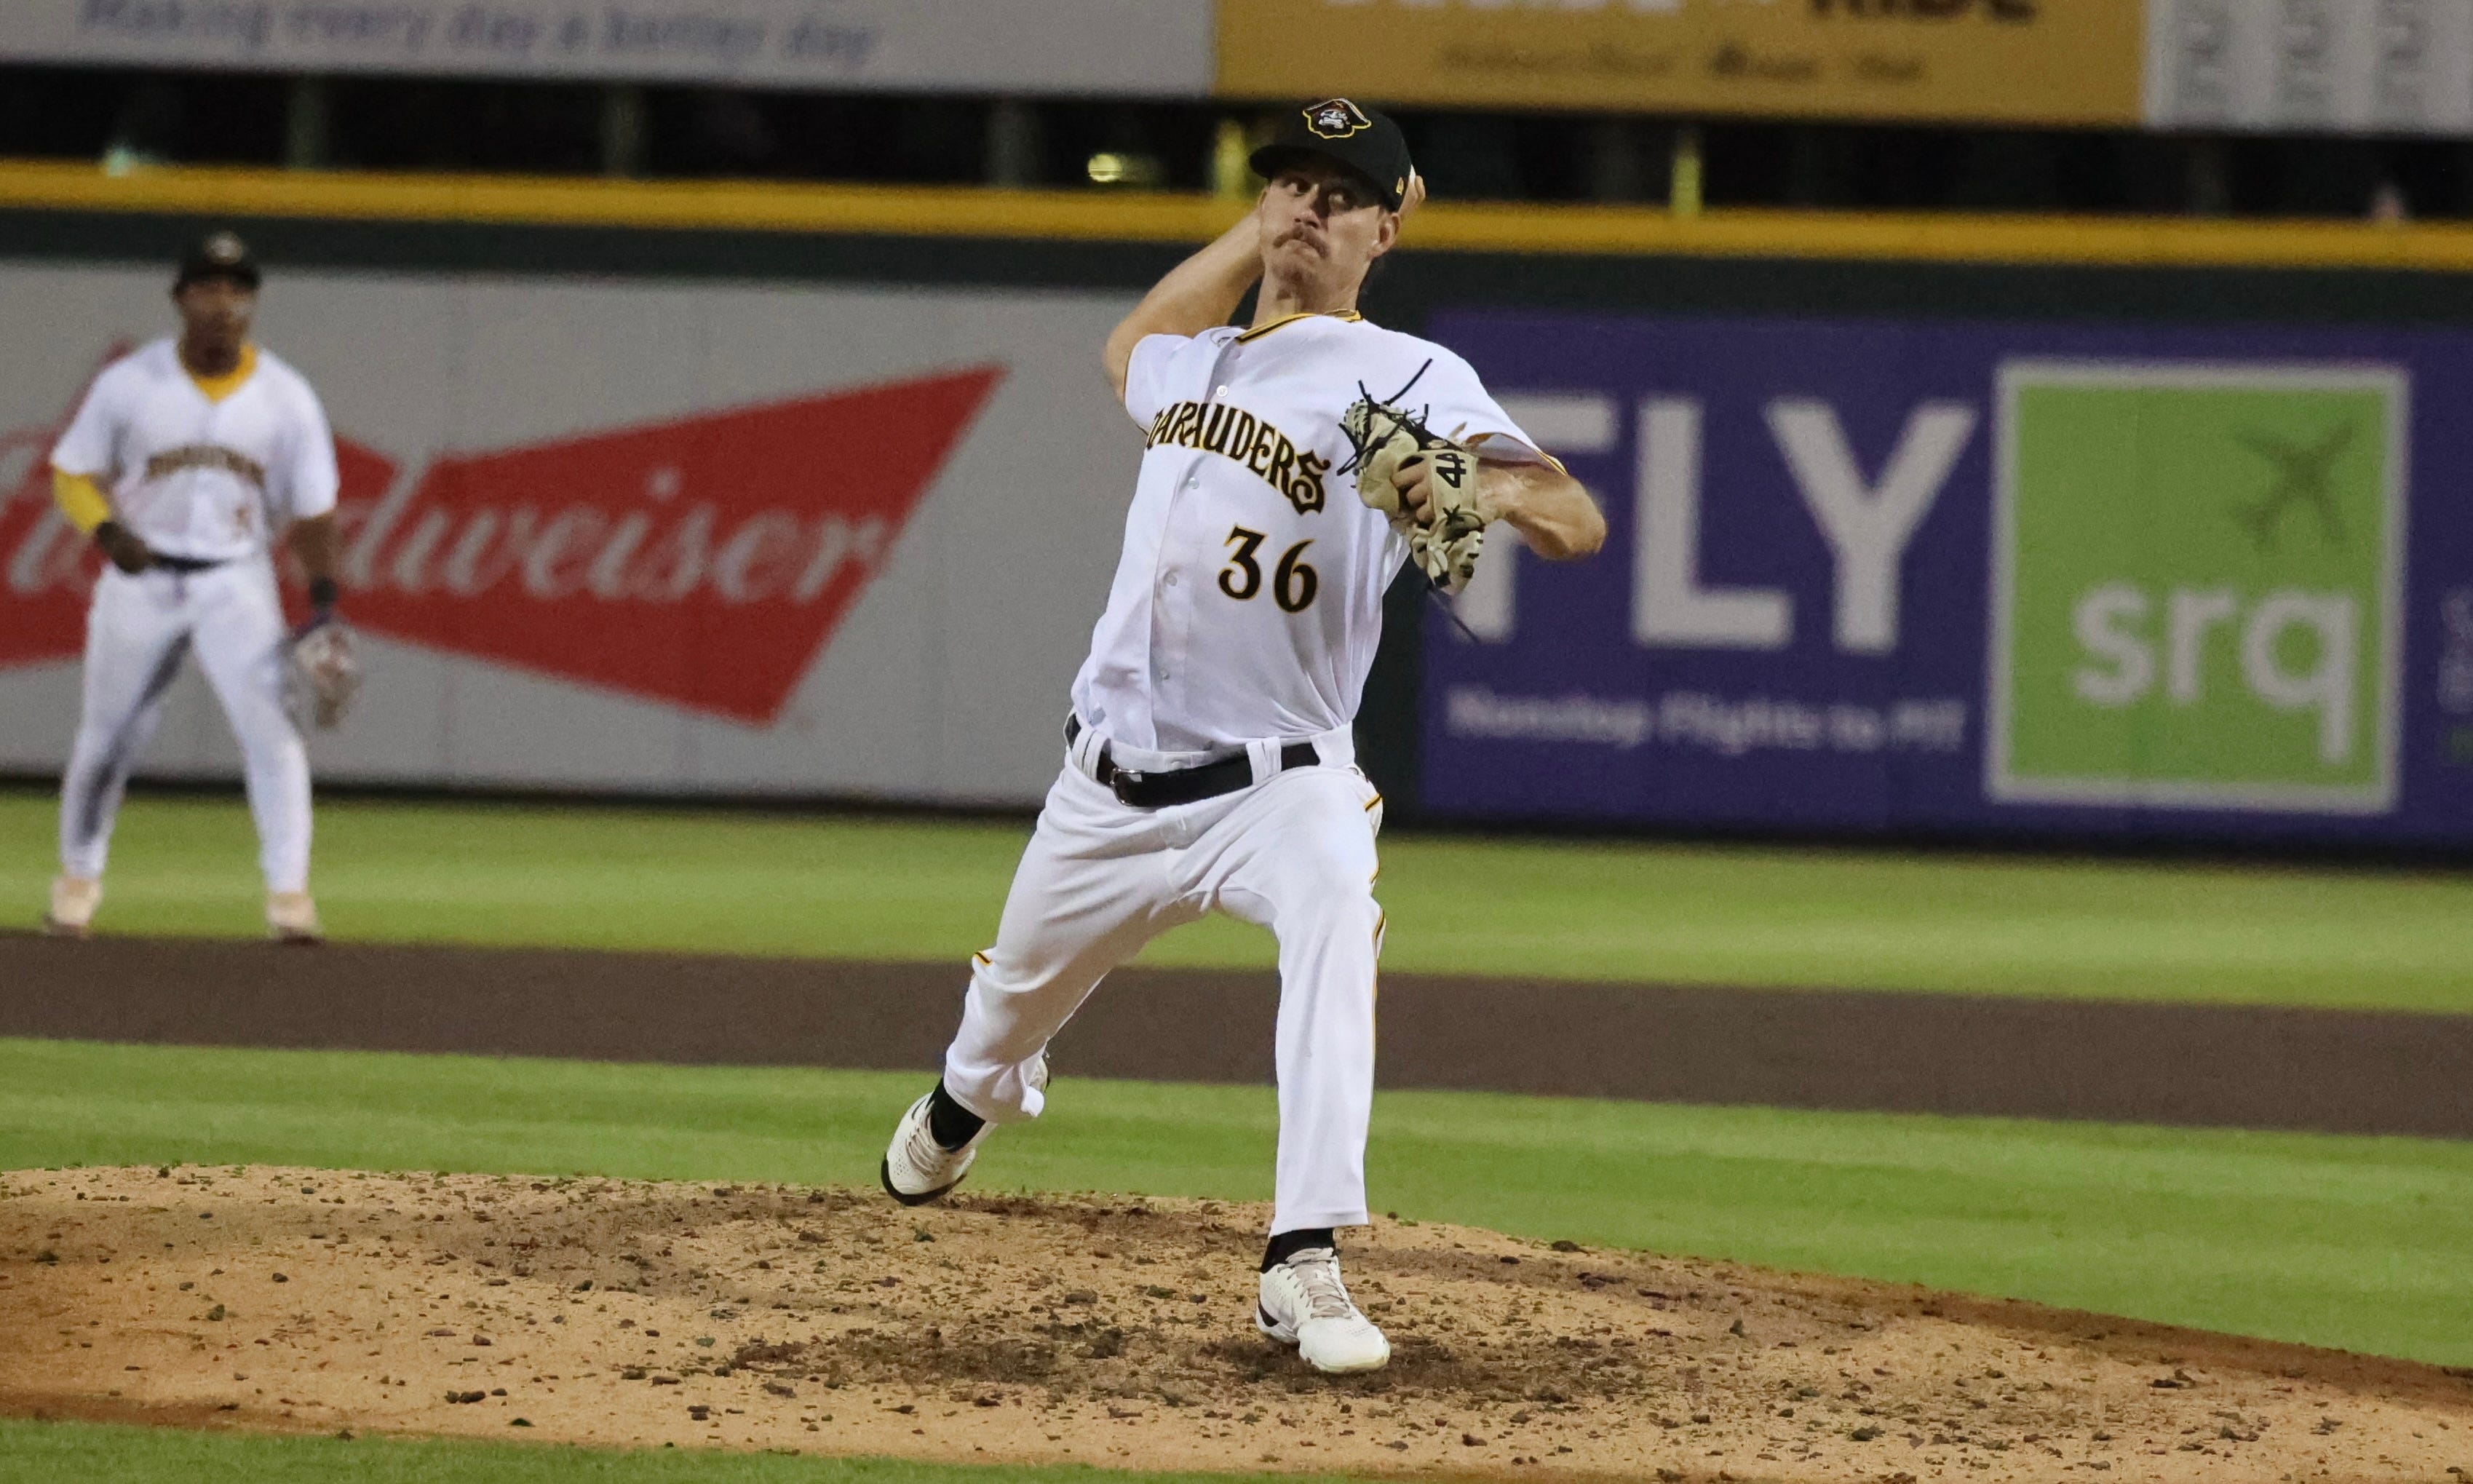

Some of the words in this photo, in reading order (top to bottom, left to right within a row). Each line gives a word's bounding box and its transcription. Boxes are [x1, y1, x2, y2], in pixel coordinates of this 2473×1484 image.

[1218, 523, 1319, 614] 36
[2071, 581, 2358, 770] srq
[1659, 691, 1824, 754] Flights
